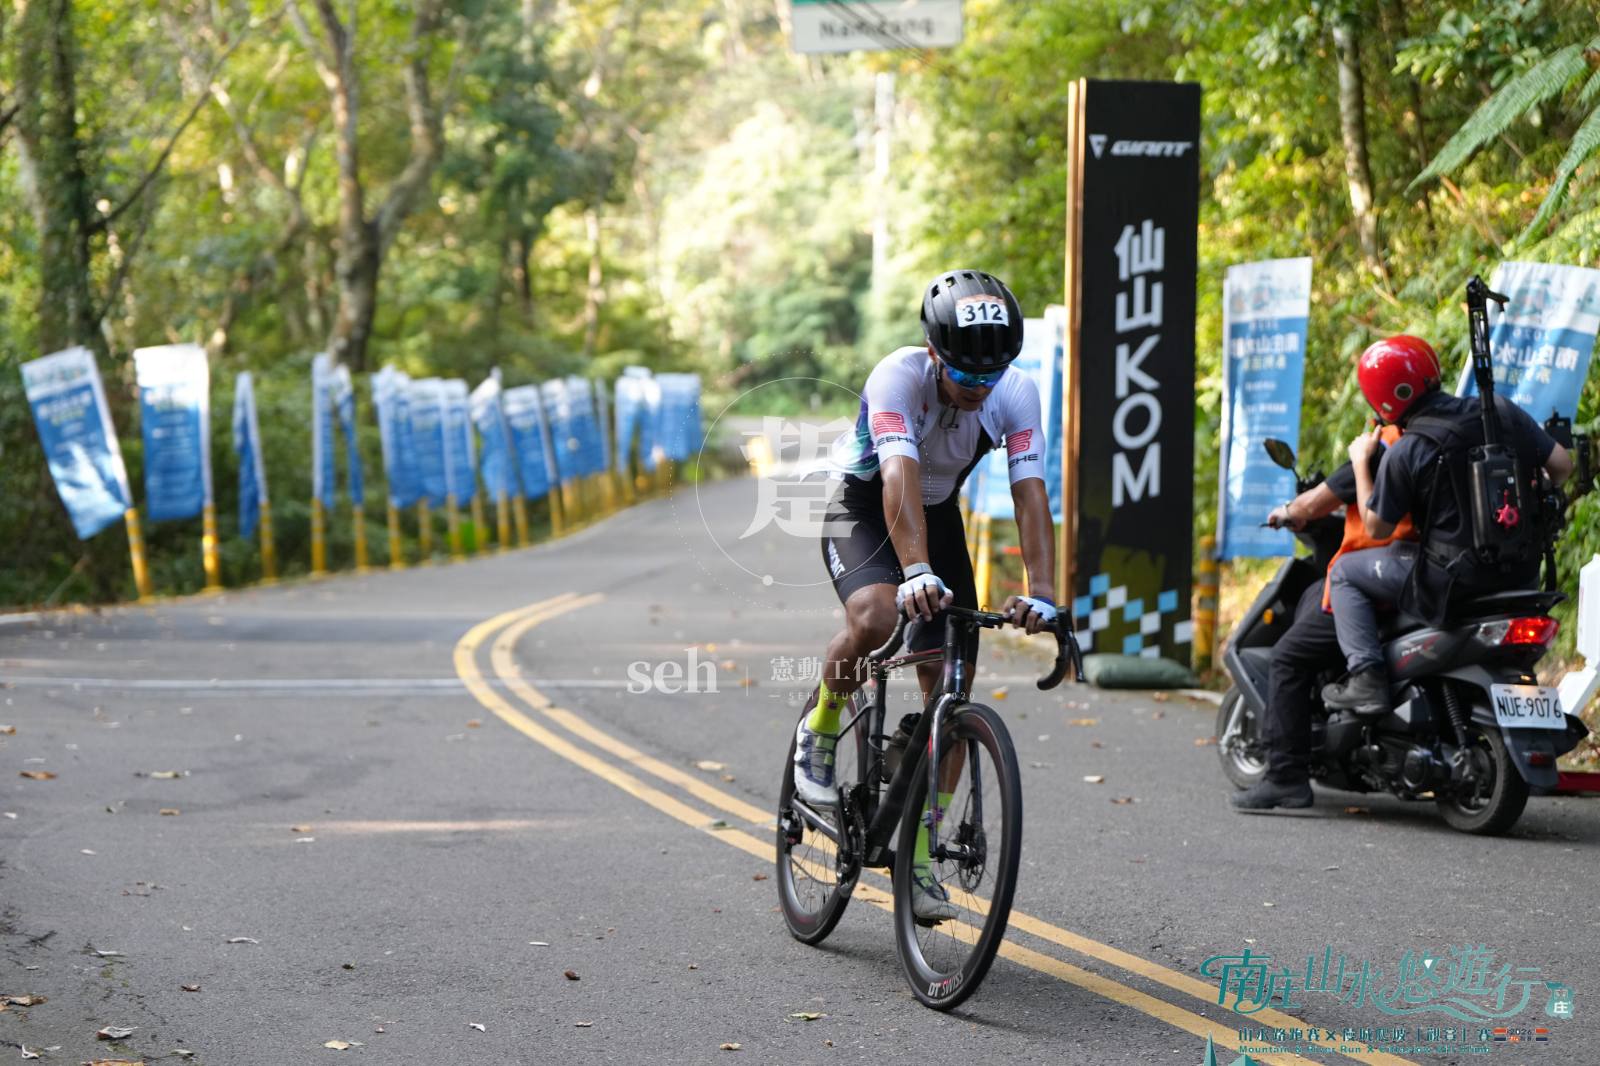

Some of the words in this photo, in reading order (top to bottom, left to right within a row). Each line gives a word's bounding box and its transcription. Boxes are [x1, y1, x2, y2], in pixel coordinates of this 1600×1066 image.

[1110, 140, 1193, 157] GIANT
[963, 303, 1003, 322] 312
[927, 982, 941, 998] DT
